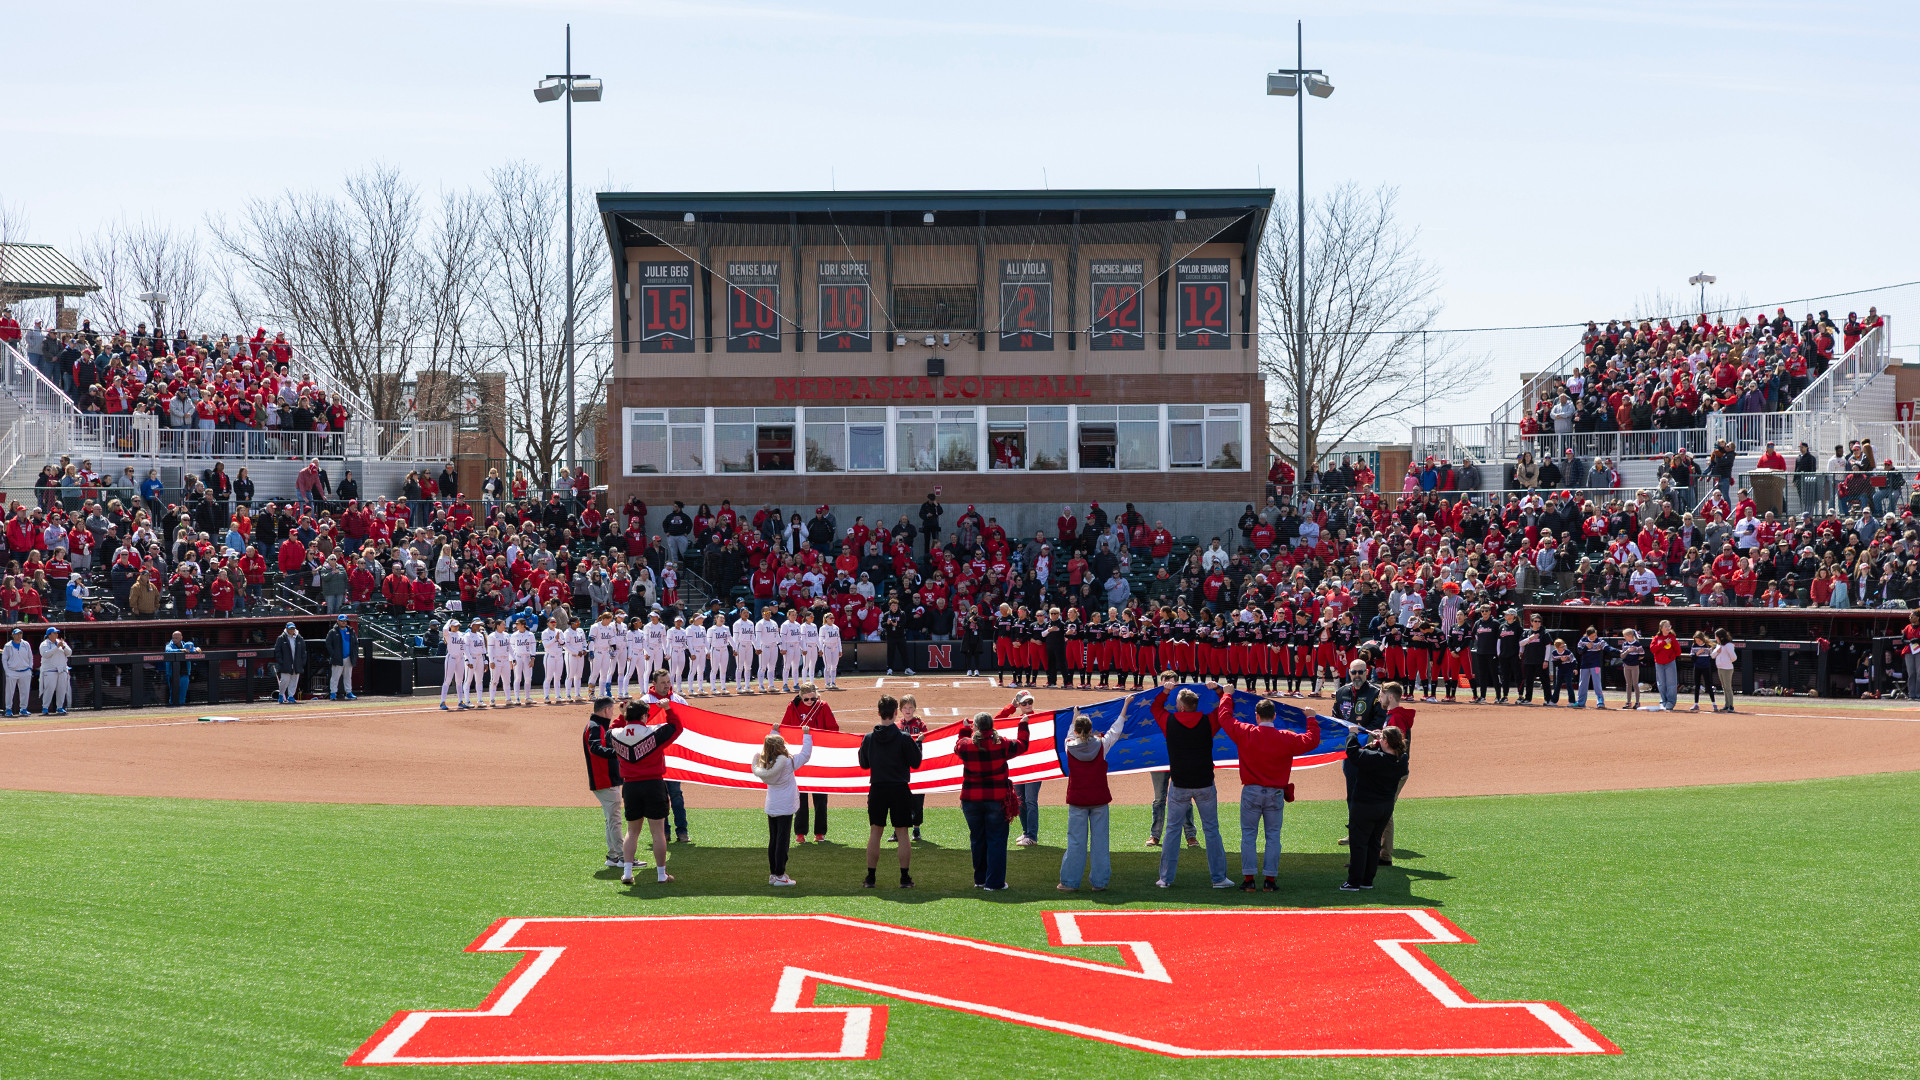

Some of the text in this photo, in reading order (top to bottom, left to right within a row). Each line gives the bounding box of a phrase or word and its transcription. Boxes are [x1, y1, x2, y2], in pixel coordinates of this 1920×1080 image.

[645, 265, 689, 278] JULIE GEIS
[729, 264, 778, 276] DENISE DAY
[820, 263, 869, 276] LORI SIPPEL
[1006, 262, 1046, 275] ALI VIOLA
[1092, 264, 1143, 274] PEACHES JAMES
[1177, 264, 1229, 274] TAYLOR EDWARDS
[647, 289, 687, 330] 15
[734, 288, 774, 329] 10
[826, 287, 863, 329] 16
[1017, 286, 1036, 328] 2
[1098, 286, 1137, 328] 42
[1184, 285, 1222, 327] 12
[661, 337, 674, 350] N
[748, 336, 761, 349] N
[838, 336, 851, 349] N
[1020, 334, 1033, 348] N
[1111, 334, 1124, 347] N
[1196, 333, 1210, 346] N
[774, 376, 1091, 400] NEBRASKA SOFTBALL
[928, 644, 952, 668] N
[625, 728, 635, 737] N
[343, 907, 1625, 1066] N
